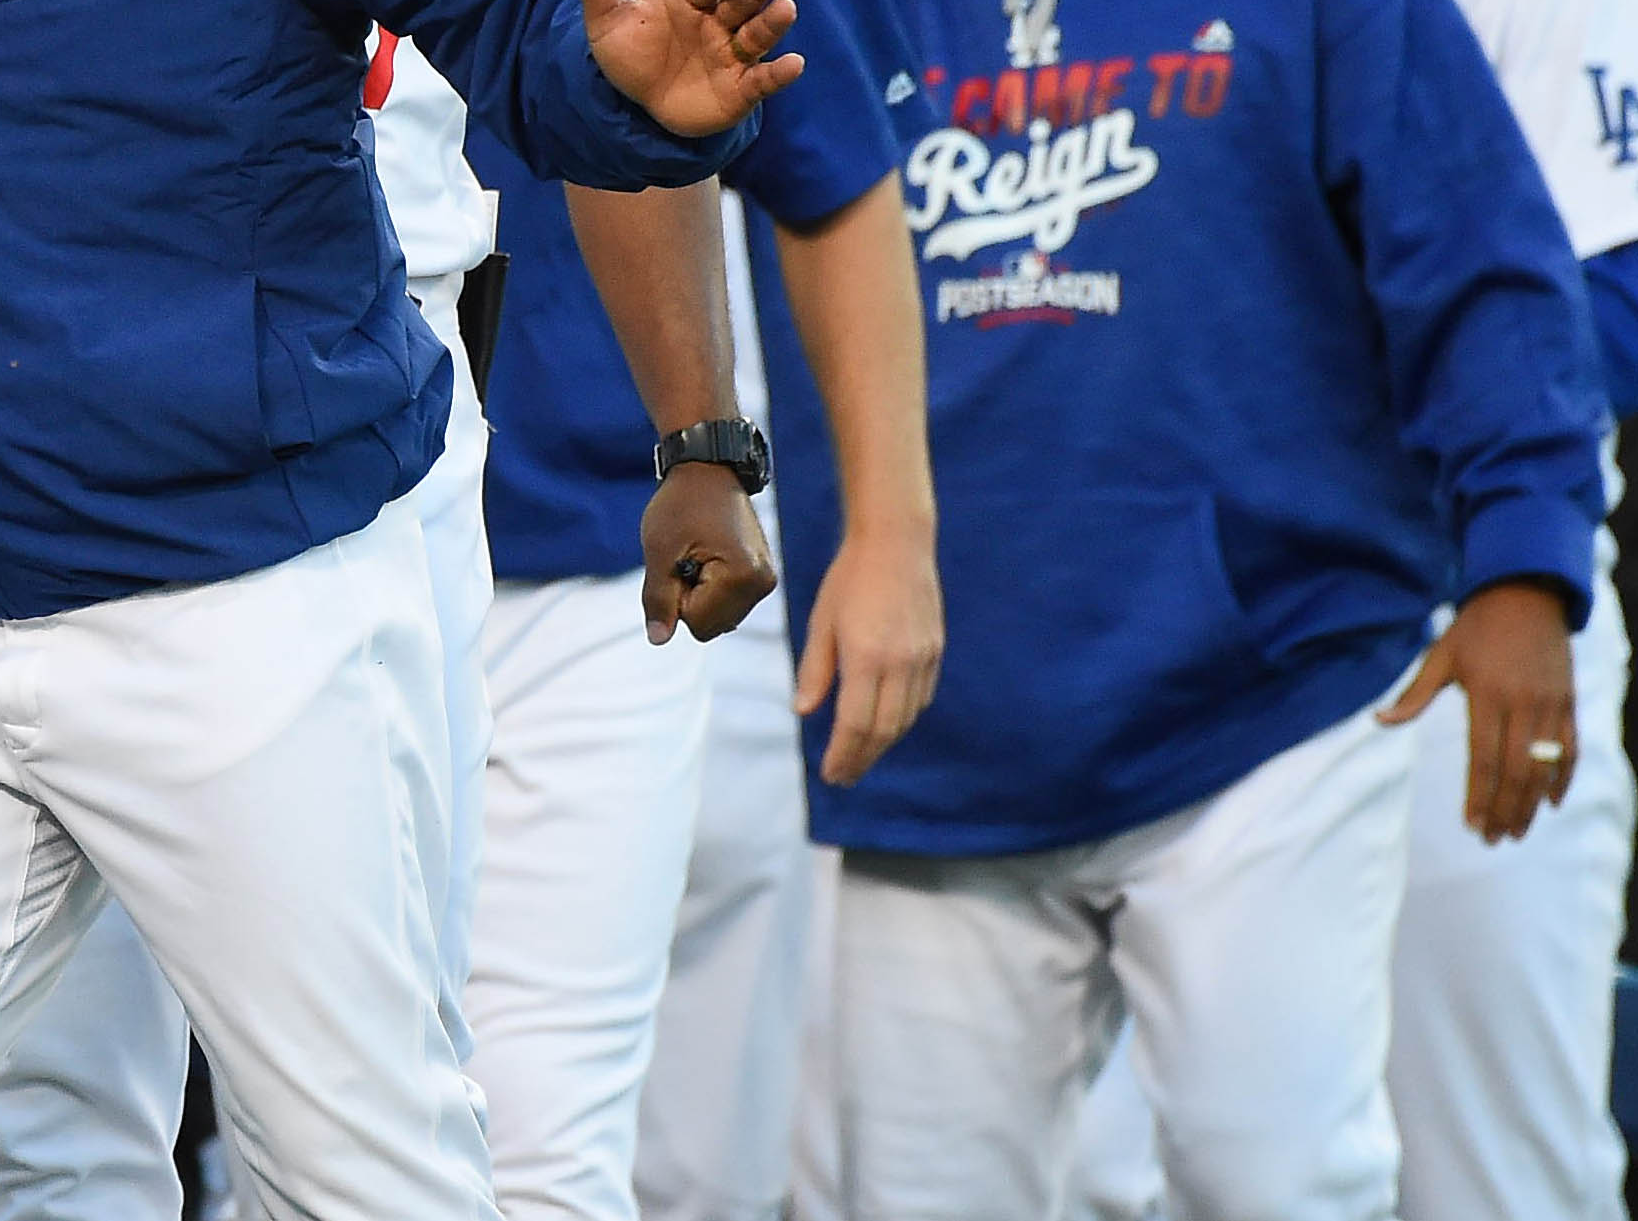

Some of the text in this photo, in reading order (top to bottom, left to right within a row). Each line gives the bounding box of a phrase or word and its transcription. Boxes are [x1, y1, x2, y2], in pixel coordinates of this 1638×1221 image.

[1147, 51, 1232, 120] TO
[904, 108, 1159, 261] Reign
[938, 271, 1121, 323] POSTSEASON
